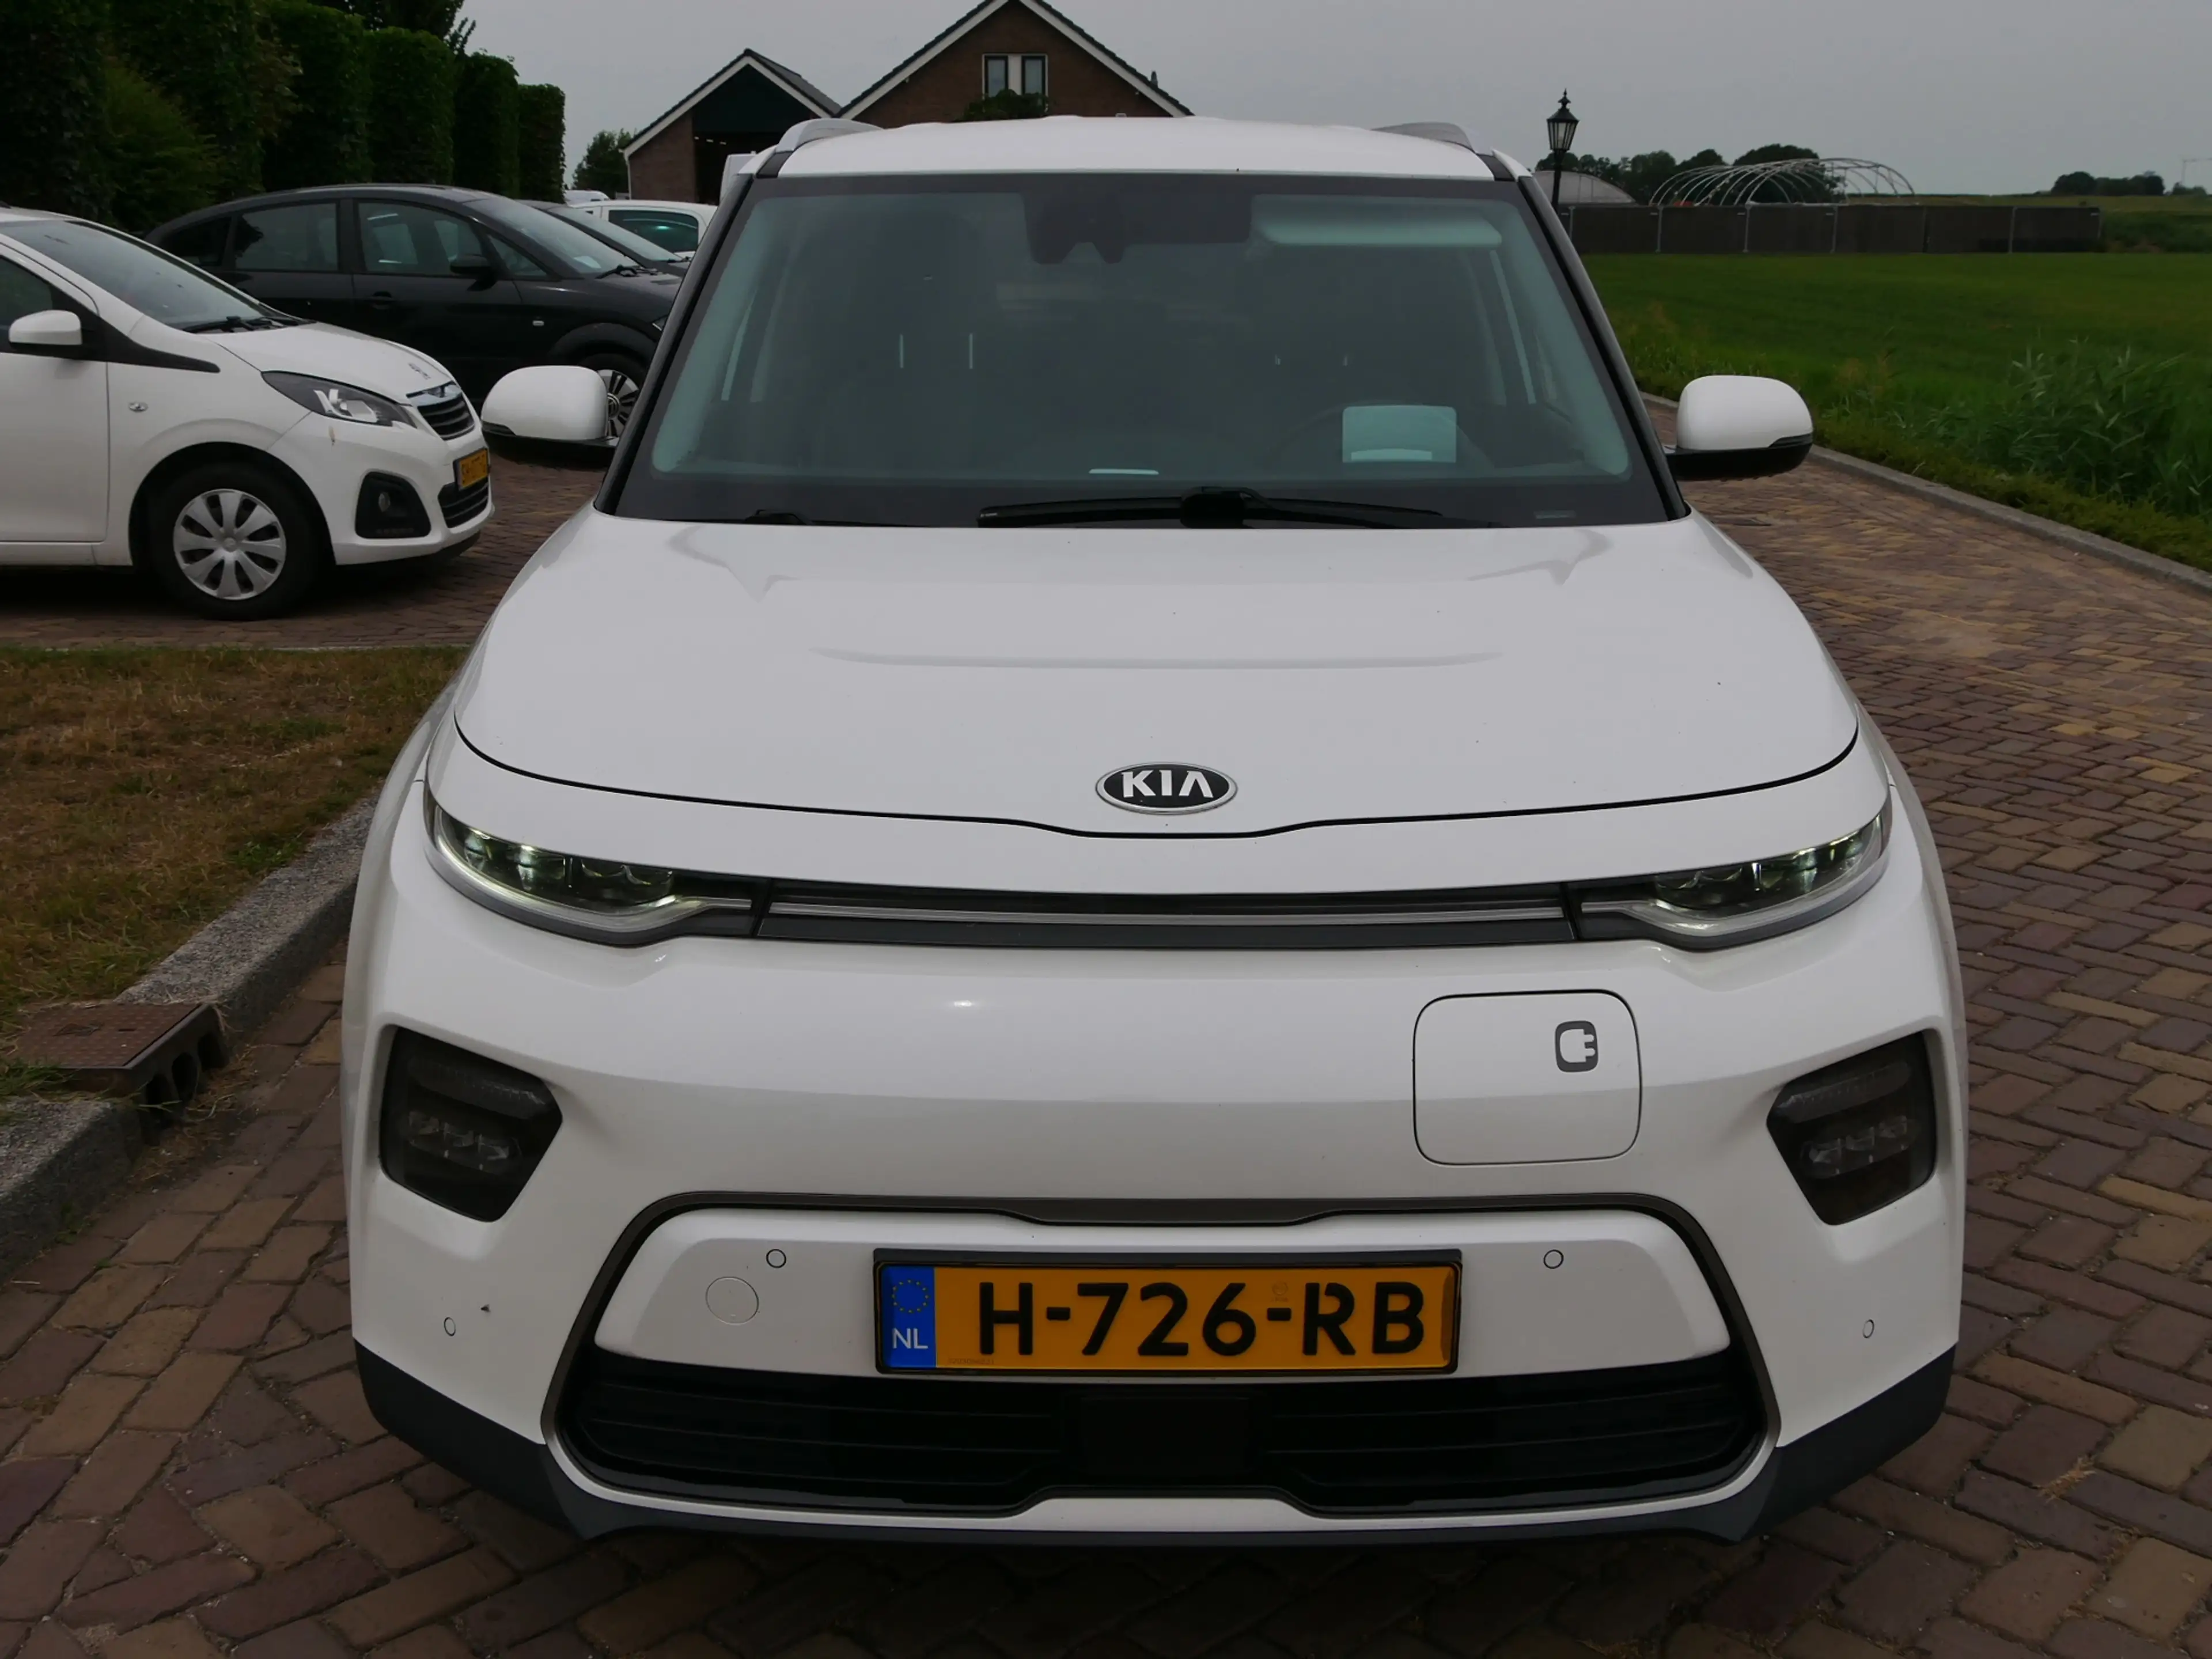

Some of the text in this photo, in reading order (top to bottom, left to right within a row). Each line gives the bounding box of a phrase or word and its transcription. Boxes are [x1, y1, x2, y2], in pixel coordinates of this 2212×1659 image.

[1121, 770, 1214, 798] KIA
[979, 1281, 1425, 1357] H-726-RB
[892, 1327, 928, 1350] NL
